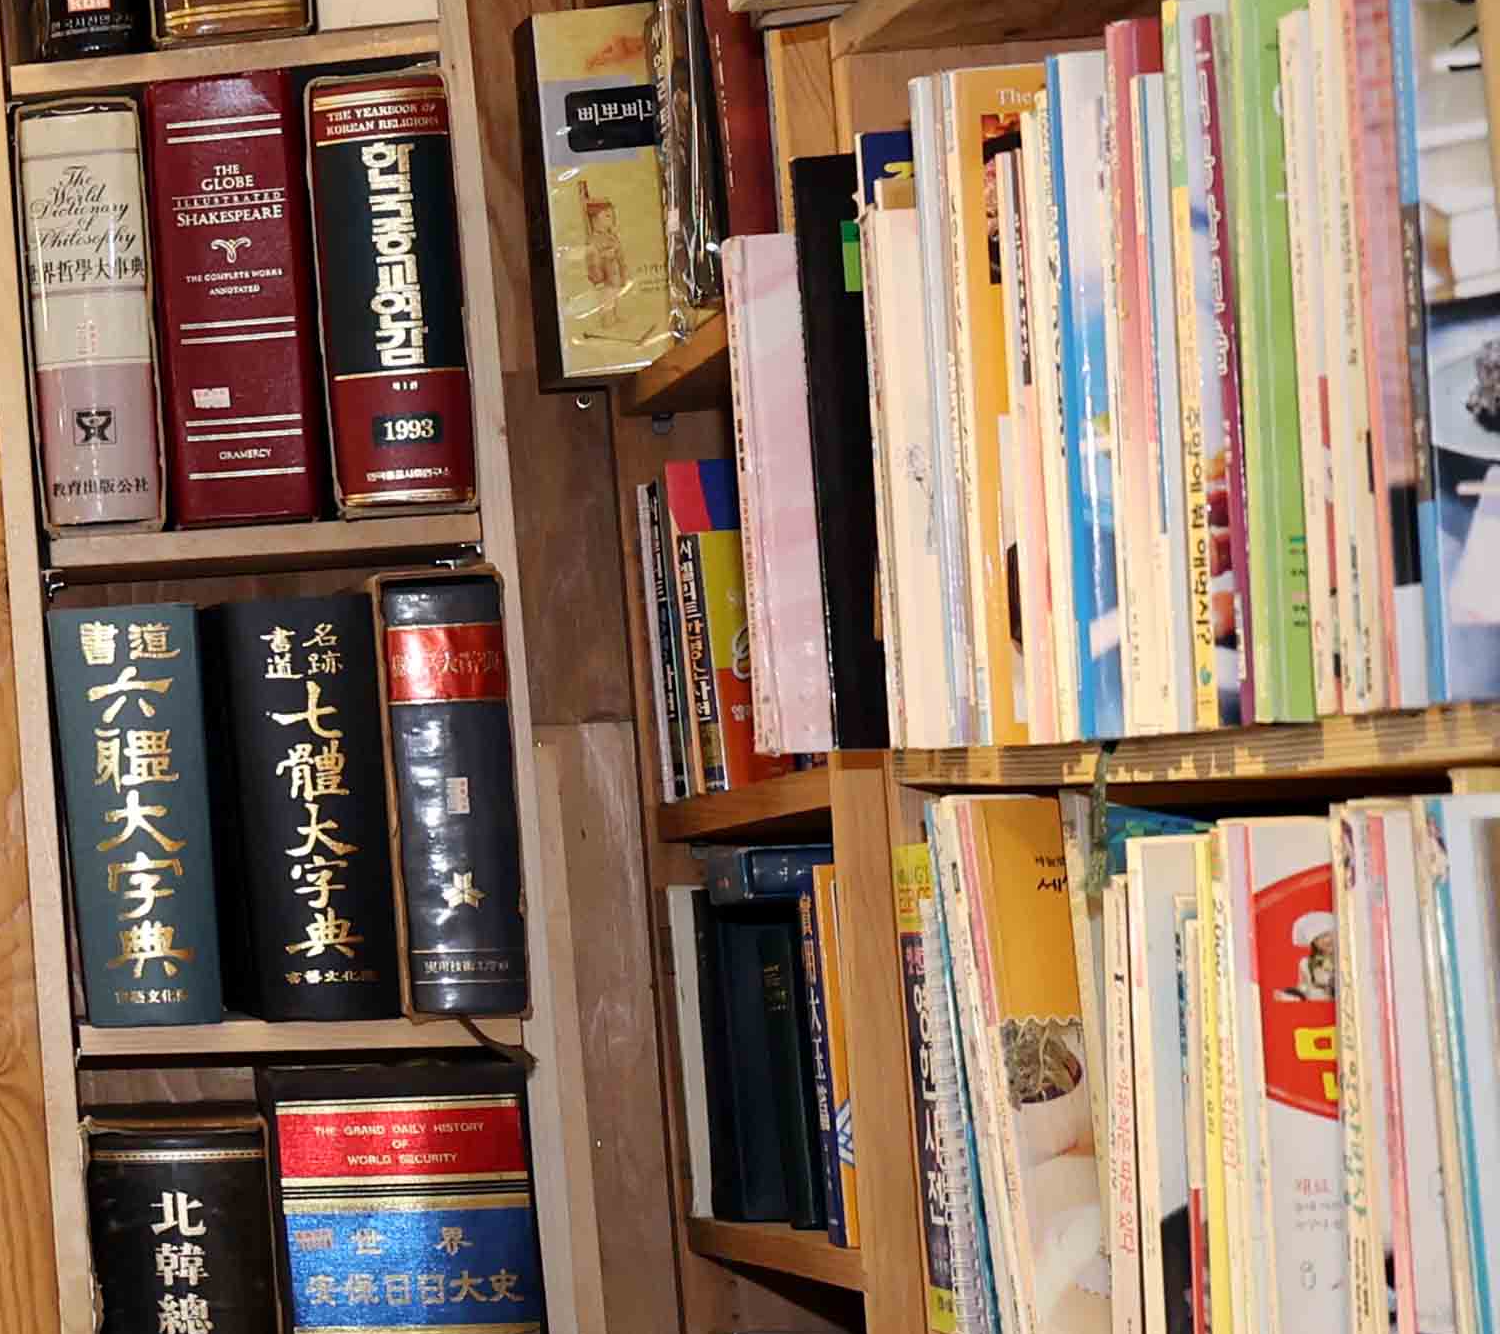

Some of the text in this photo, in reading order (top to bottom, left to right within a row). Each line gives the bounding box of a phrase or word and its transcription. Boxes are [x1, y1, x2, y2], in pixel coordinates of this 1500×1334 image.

[996, 87, 1032, 107] The
[326, 109, 352, 123] THE
[353, 104, 418, 119] YEARBOOK
[325, 121, 376, 137] KOREAN
[58, 166, 94, 188] The
[213, 163, 241, 177] THE
[201, 175, 255, 191] GLOBE
[48, 185, 106, 207] World
[175, 190, 282, 208] ILLUSTRATED
[28, 201, 129, 221] Dictionary
[176, 204, 283, 228] SHAKESPEARE
[27, 229, 137, 255] Philosophy
[360, 141, 429, 367] 한국종교연감
[382, 418, 435, 441] 1993
[219, 447, 273, 461] GRAMERCY
[314, 1121, 484, 1138] THE GRAND DAILY HISTORY
[347, 1152, 459, 1165] WORLD SECURITY
